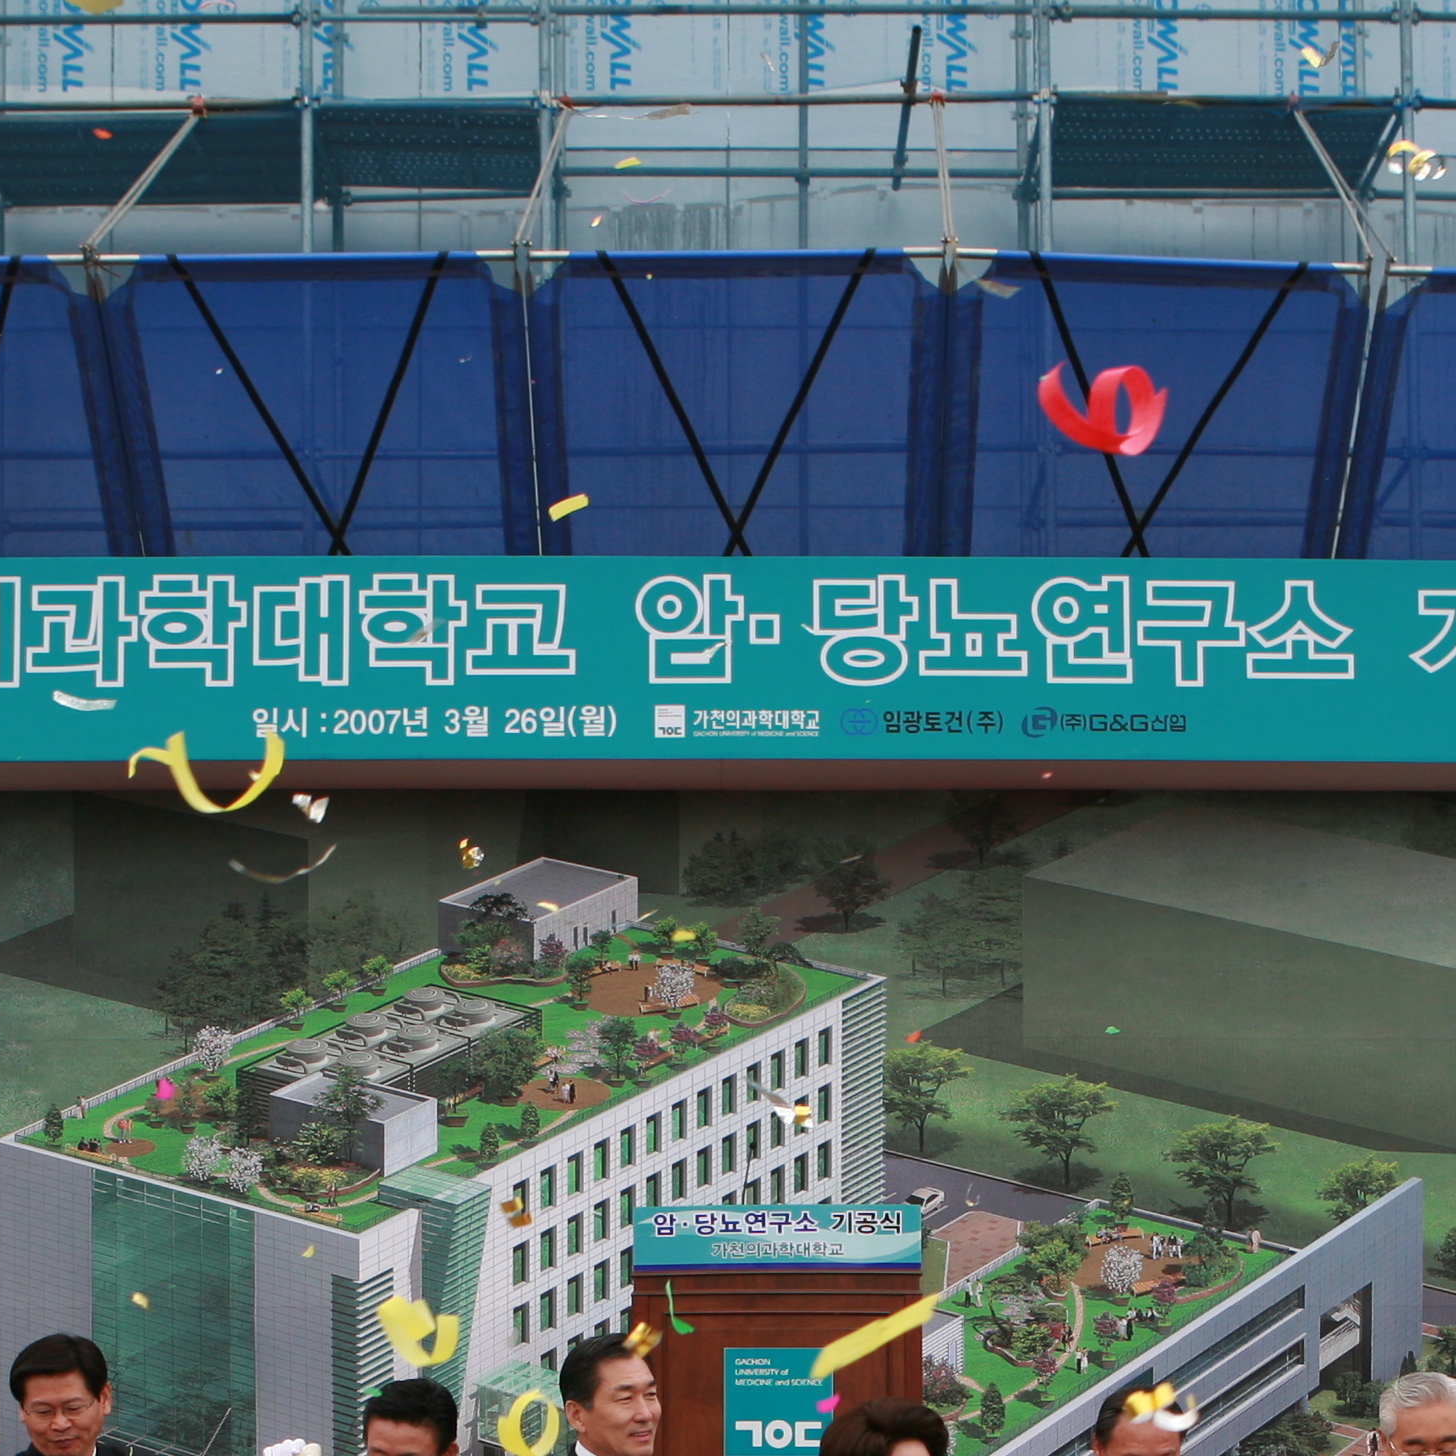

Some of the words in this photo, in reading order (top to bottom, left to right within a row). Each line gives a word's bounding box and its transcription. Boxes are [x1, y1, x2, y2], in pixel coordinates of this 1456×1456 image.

[252, 707, 308, 738] 일시
[444, 706, 489, 738] 3월
[504, 705, 618, 738] 26일(월)
[693, 710, 820, 729] 가천의과학대학교
[831, 1210, 903, 1235] 기공식
[711, 1241, 845, 1259] 가천의과학대학교
